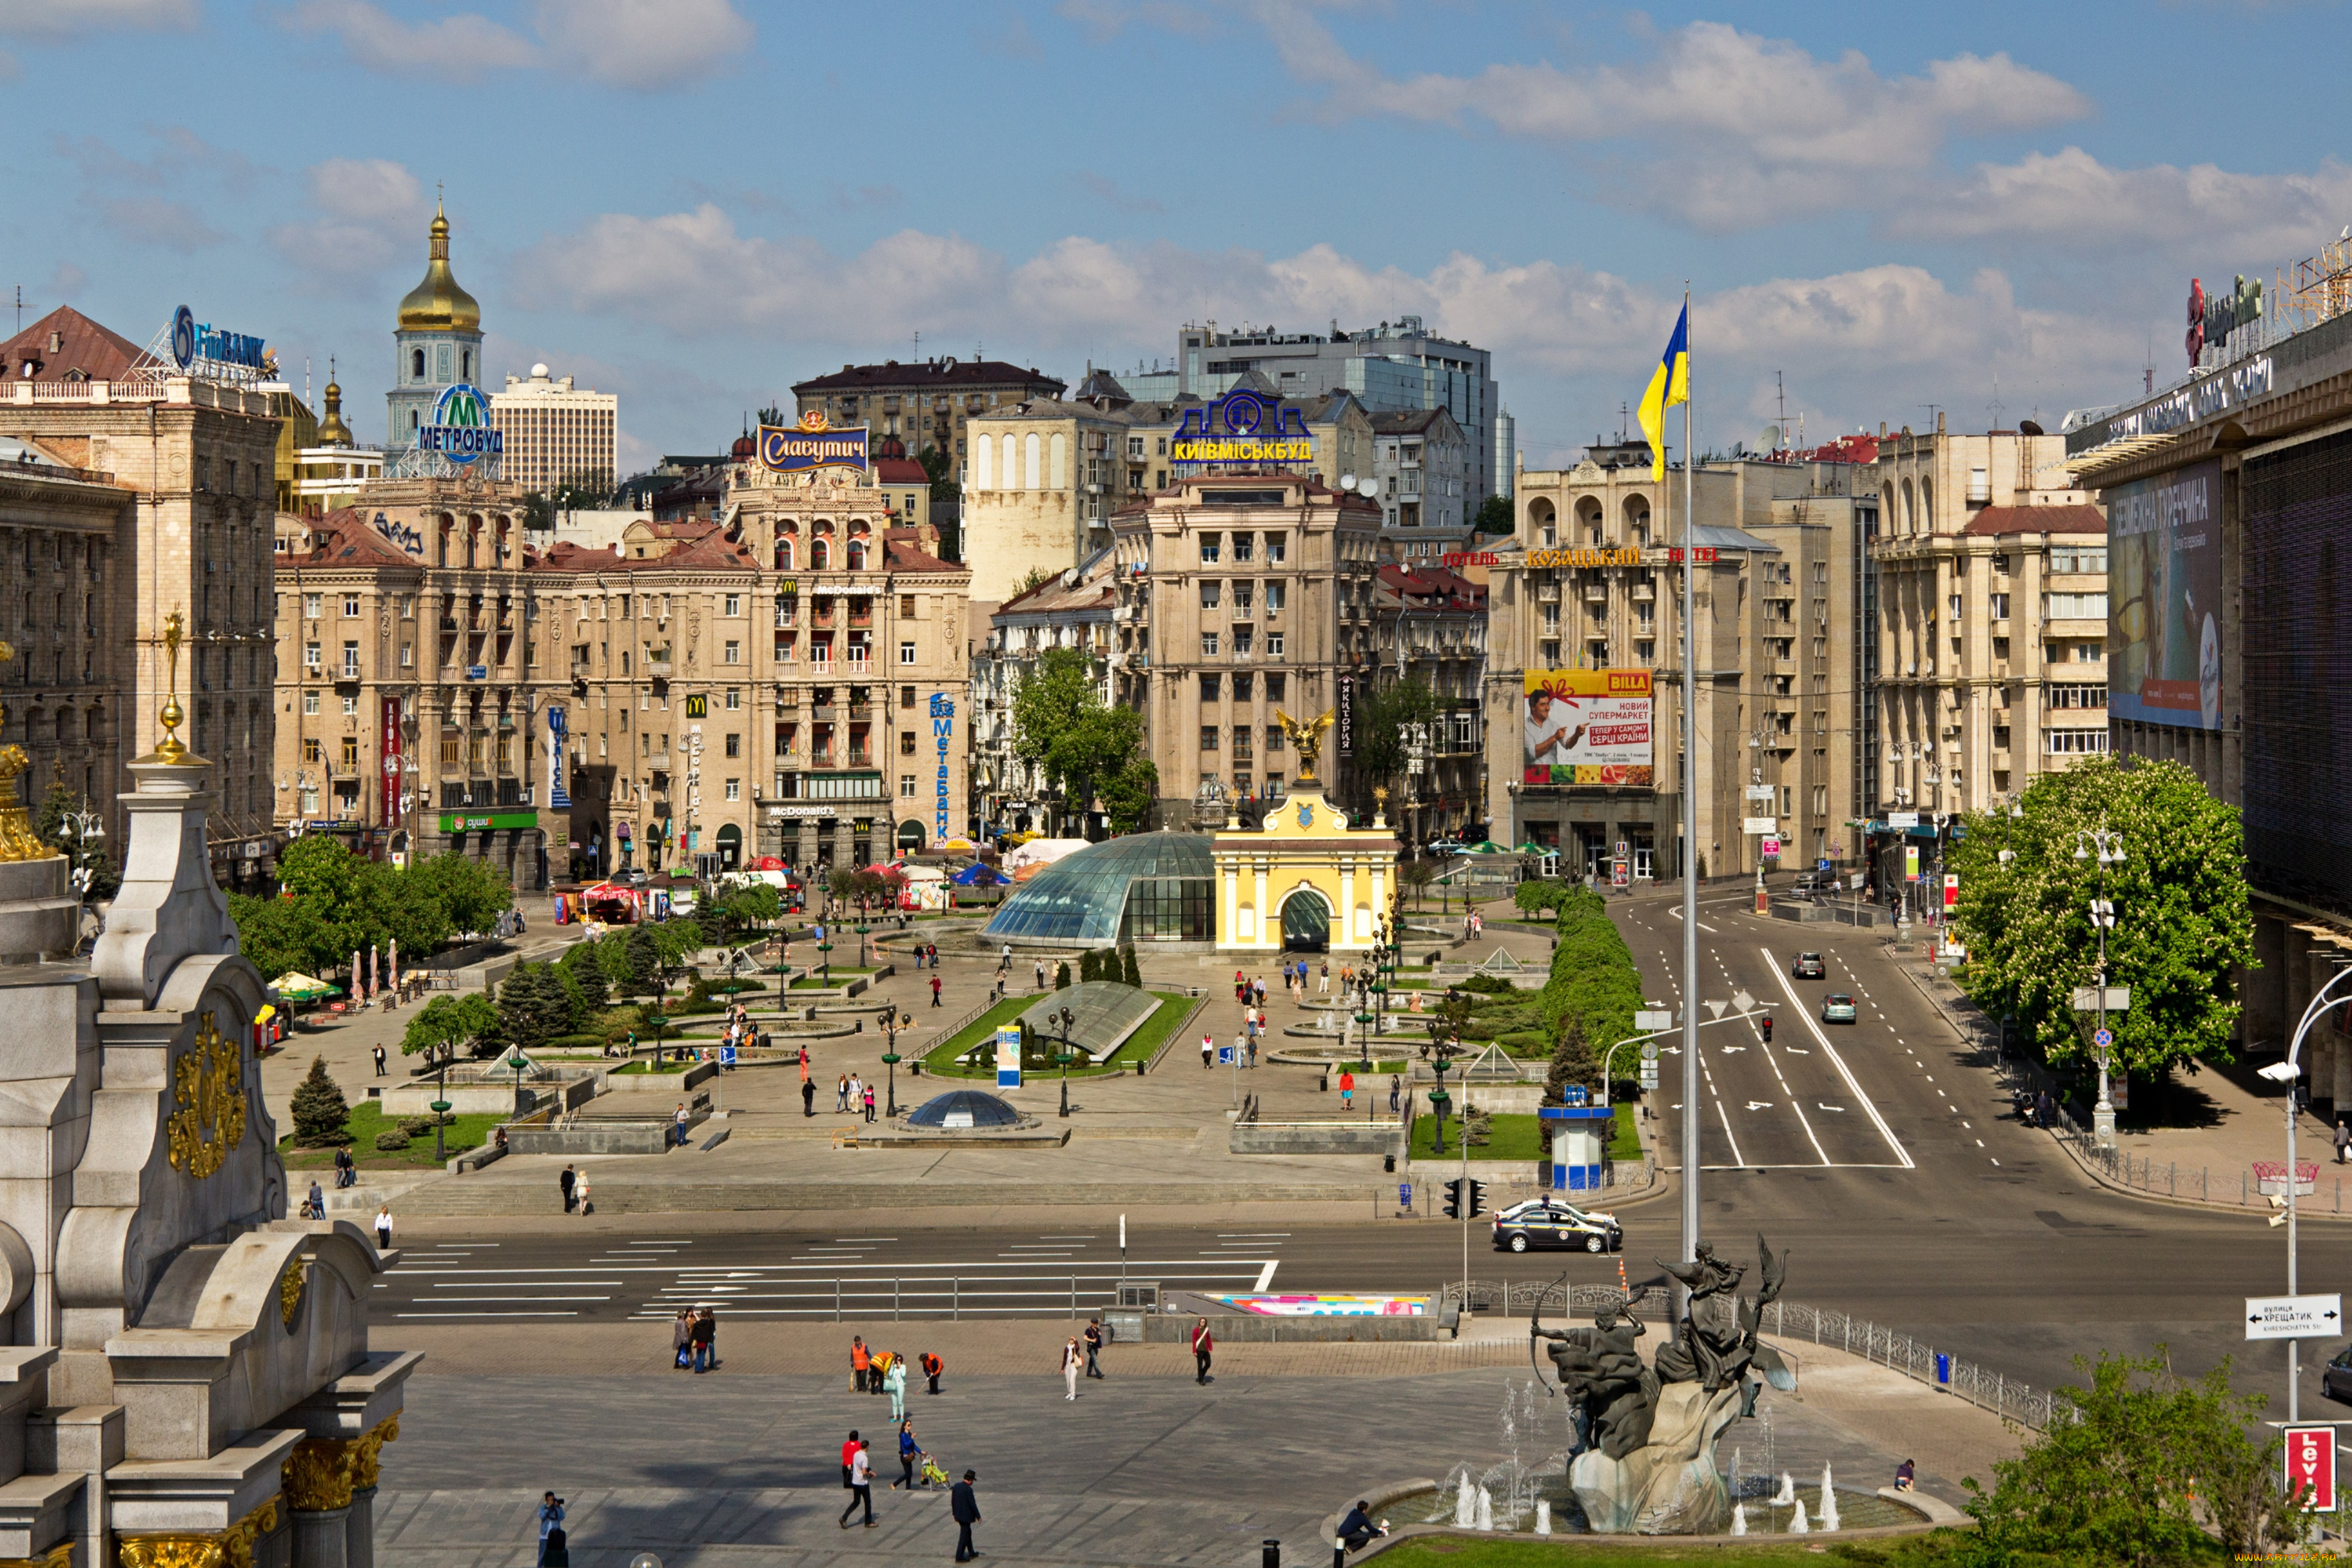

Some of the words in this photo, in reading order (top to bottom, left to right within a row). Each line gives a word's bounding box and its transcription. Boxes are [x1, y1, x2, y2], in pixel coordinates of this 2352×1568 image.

[195, 322, 265, 369] FinBANK
[418, 425, 503, 452] МЕТРОБУД
[764, 432, 866, 465] Славутич
[1175, 441, 1312, 460] КИЇВМІСЬКБУД
[2116, 491, 2157, 537] БЕЗМЕЖНА
[2158, 477, 2209, 529] ТУРЕЧЧИНА
[1443, 551, 1499, 567] ГОТЕЛЬ
[1527, 546, 1640, 569] КОЗАЦЬКИЙ
[817, 586, 881, 594] McDonald's
[1611, 677, 1646, 688] BILLA
[1620, 701, 1648, 710] НОВИЙ
[1618, 724, 1647, 733] САМОМУ
[1591, 735, 1616, 745] СЕРЦІ
[1617, 731, 1647, 742] КРАЇНИ
[934, 719, 951, 838] МетаБанк
[770, 807, 835, 817] McDonald's
[2264, 1312, 2312, 1323] ХРЕЩАТИК
